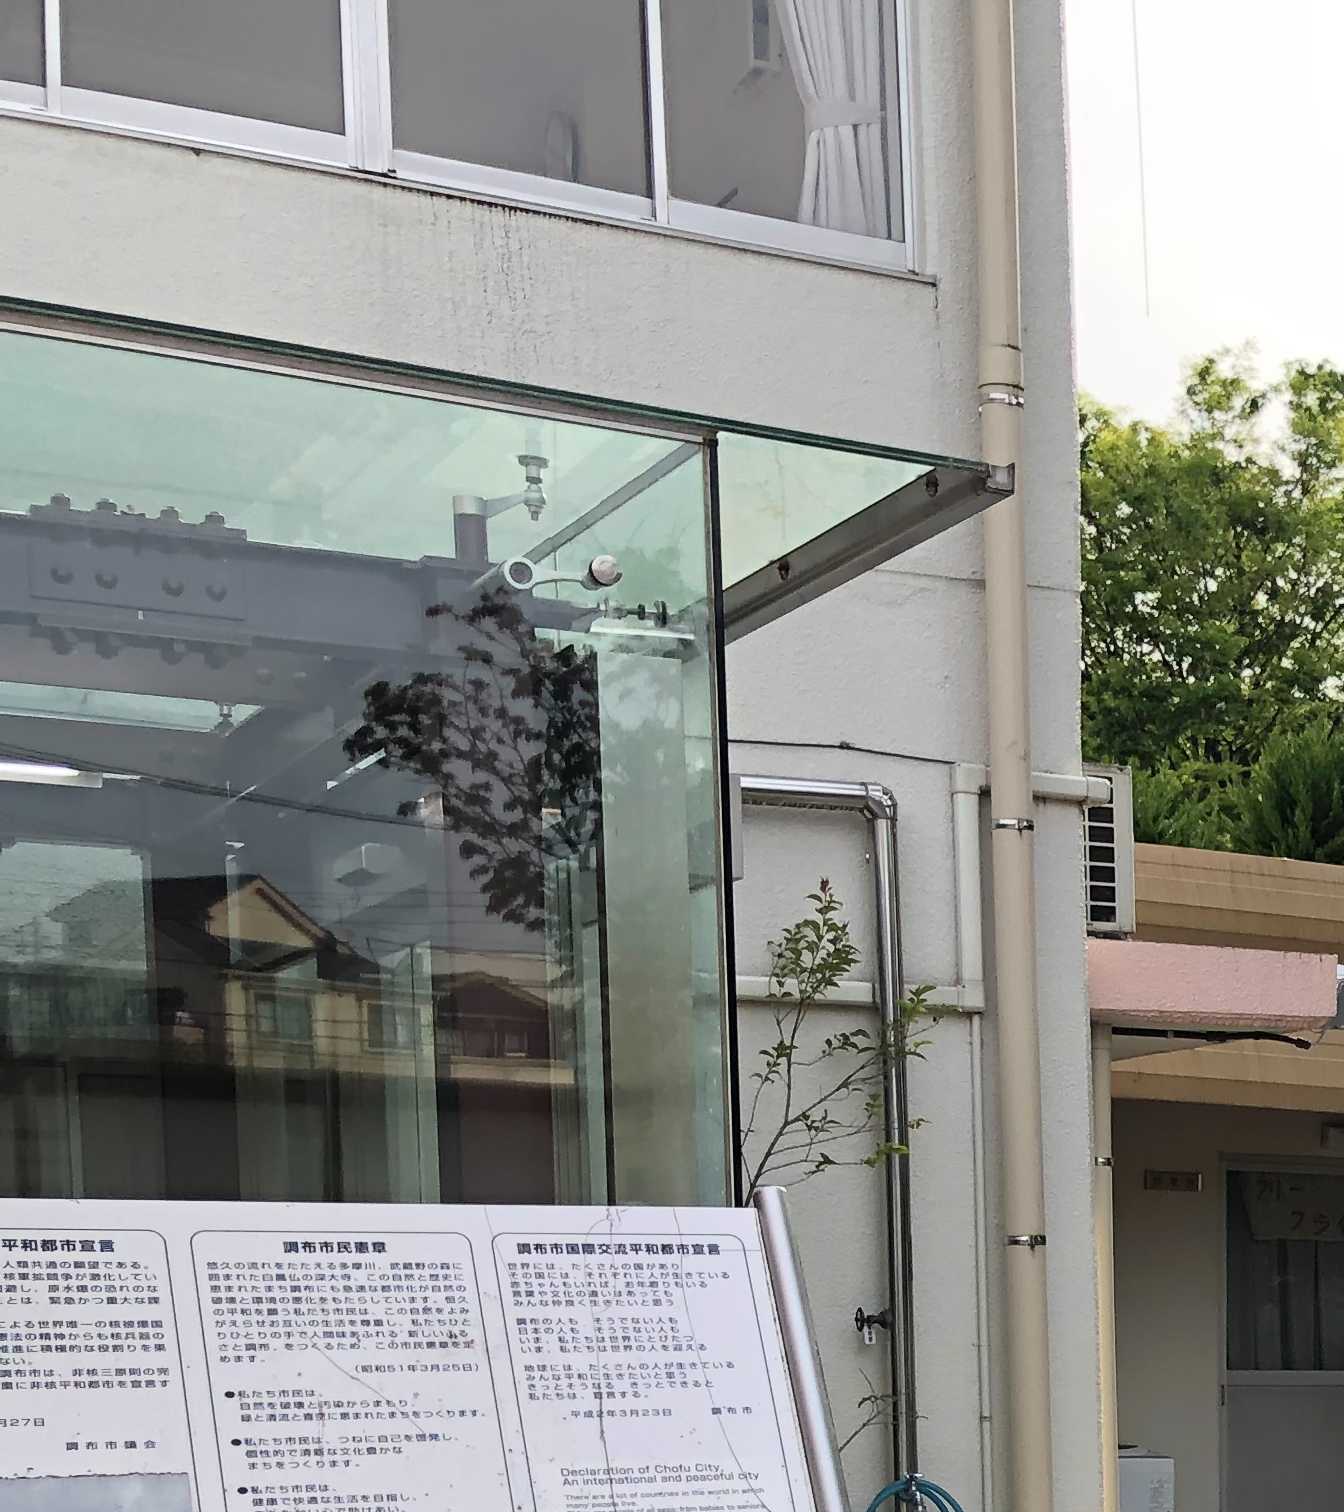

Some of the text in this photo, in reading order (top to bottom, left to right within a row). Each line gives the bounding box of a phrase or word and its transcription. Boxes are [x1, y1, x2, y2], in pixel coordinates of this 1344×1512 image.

[1, 1238, 116, 1253] 平和都市宣言
[282, 1240, 388, 1255] 調布市民憲章
[516, 1242, 721, 1256] 調布市国際交流平和都市宣言
[0, 1284, 160, 1294] 避し、原水爆の恐れのな
[560, 1466, 635, 1477] Declaration
[638, 1465, 649, 1474] of
[655, 1463, 691, 1474] Chofu
[563, 1470, 760, 1486] An international and peaceful city
